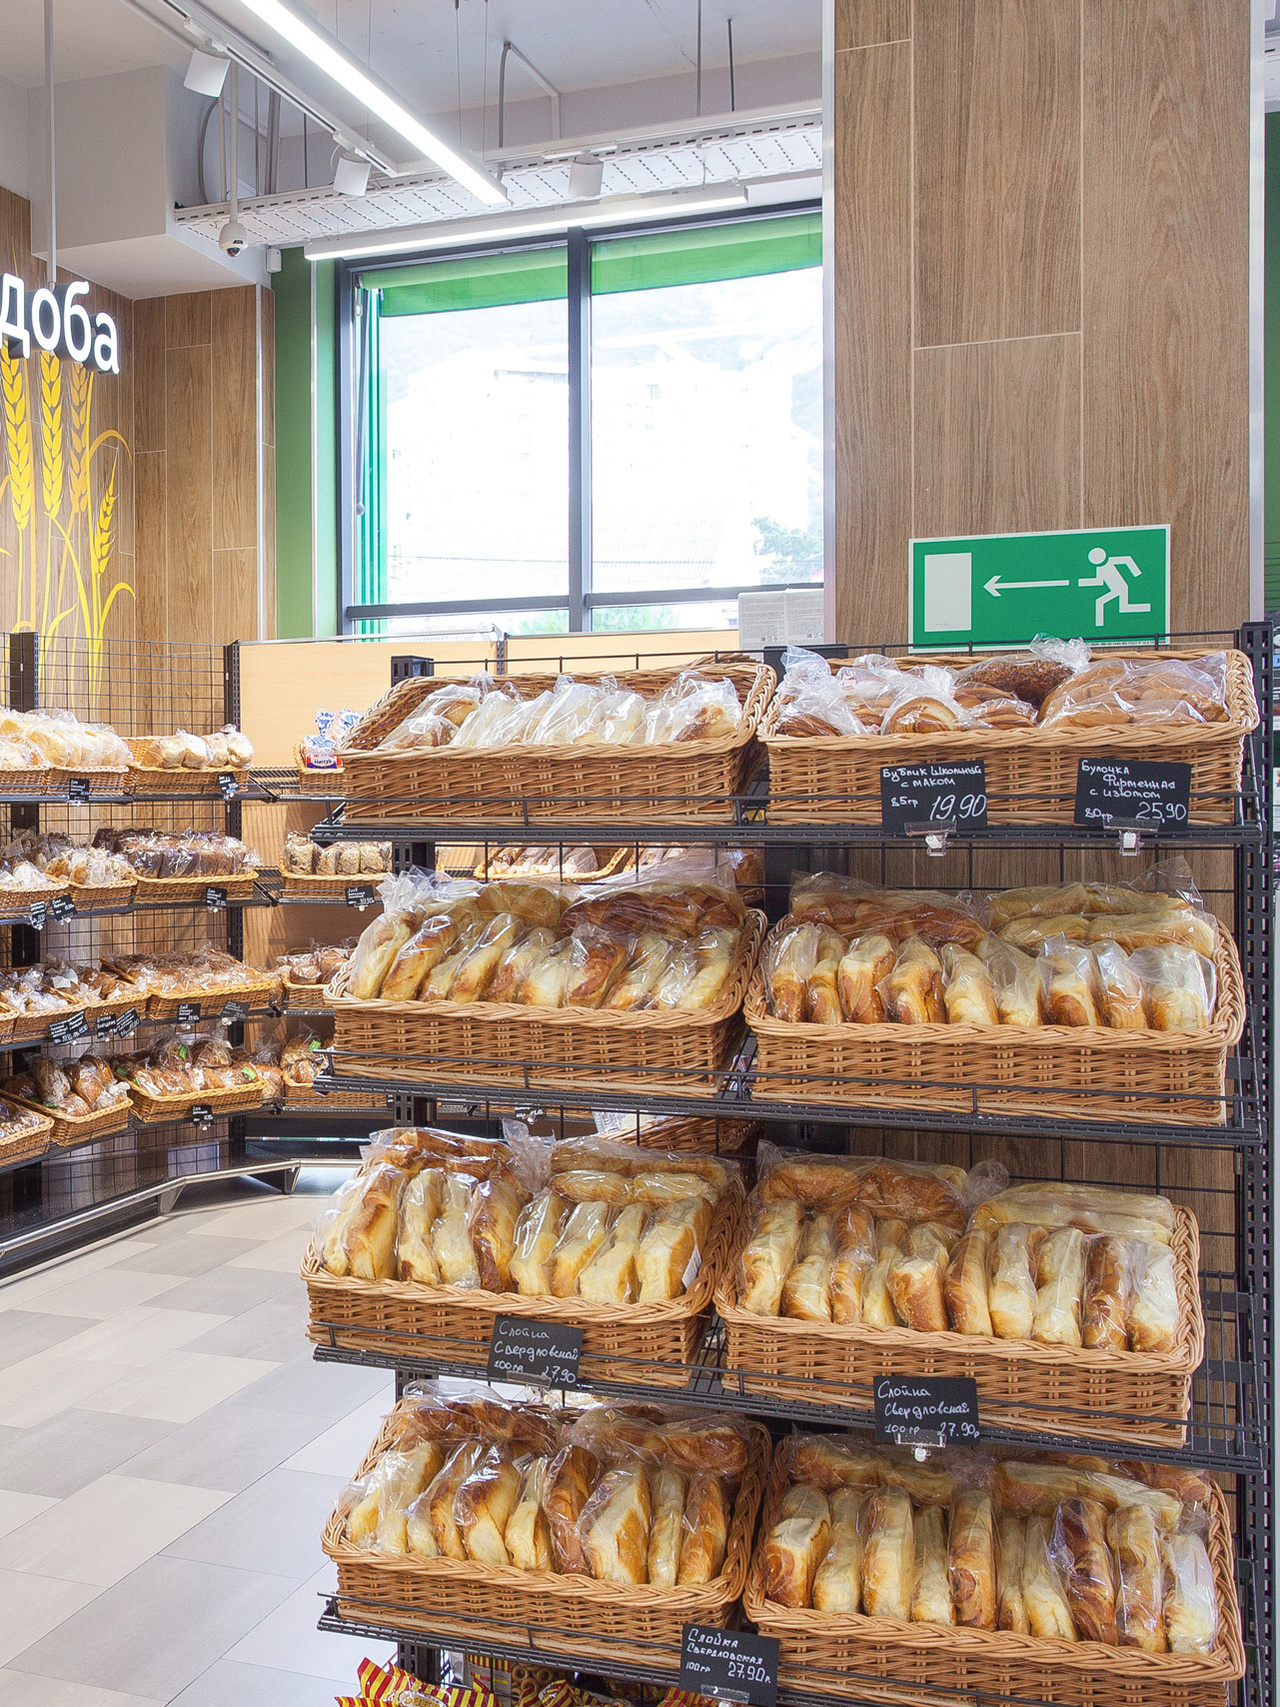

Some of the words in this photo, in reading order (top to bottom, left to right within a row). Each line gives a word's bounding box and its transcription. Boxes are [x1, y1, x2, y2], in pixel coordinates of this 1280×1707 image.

[882, 767, 928, 782] Бублик
[929, 765, 982, 776] Школьный
[1081, 759, 1130, 776] Булочка
[1102, 773, 1176, 790] Фирменная
[1089, 788, 1099, 796] с
[1103, 787, 1161, 799] изюмом
[929, 793, 987, 822] 19,90
[1135, 801, 1187, 824] 25,90
[877, 1380, 931, 1398] Слойка
